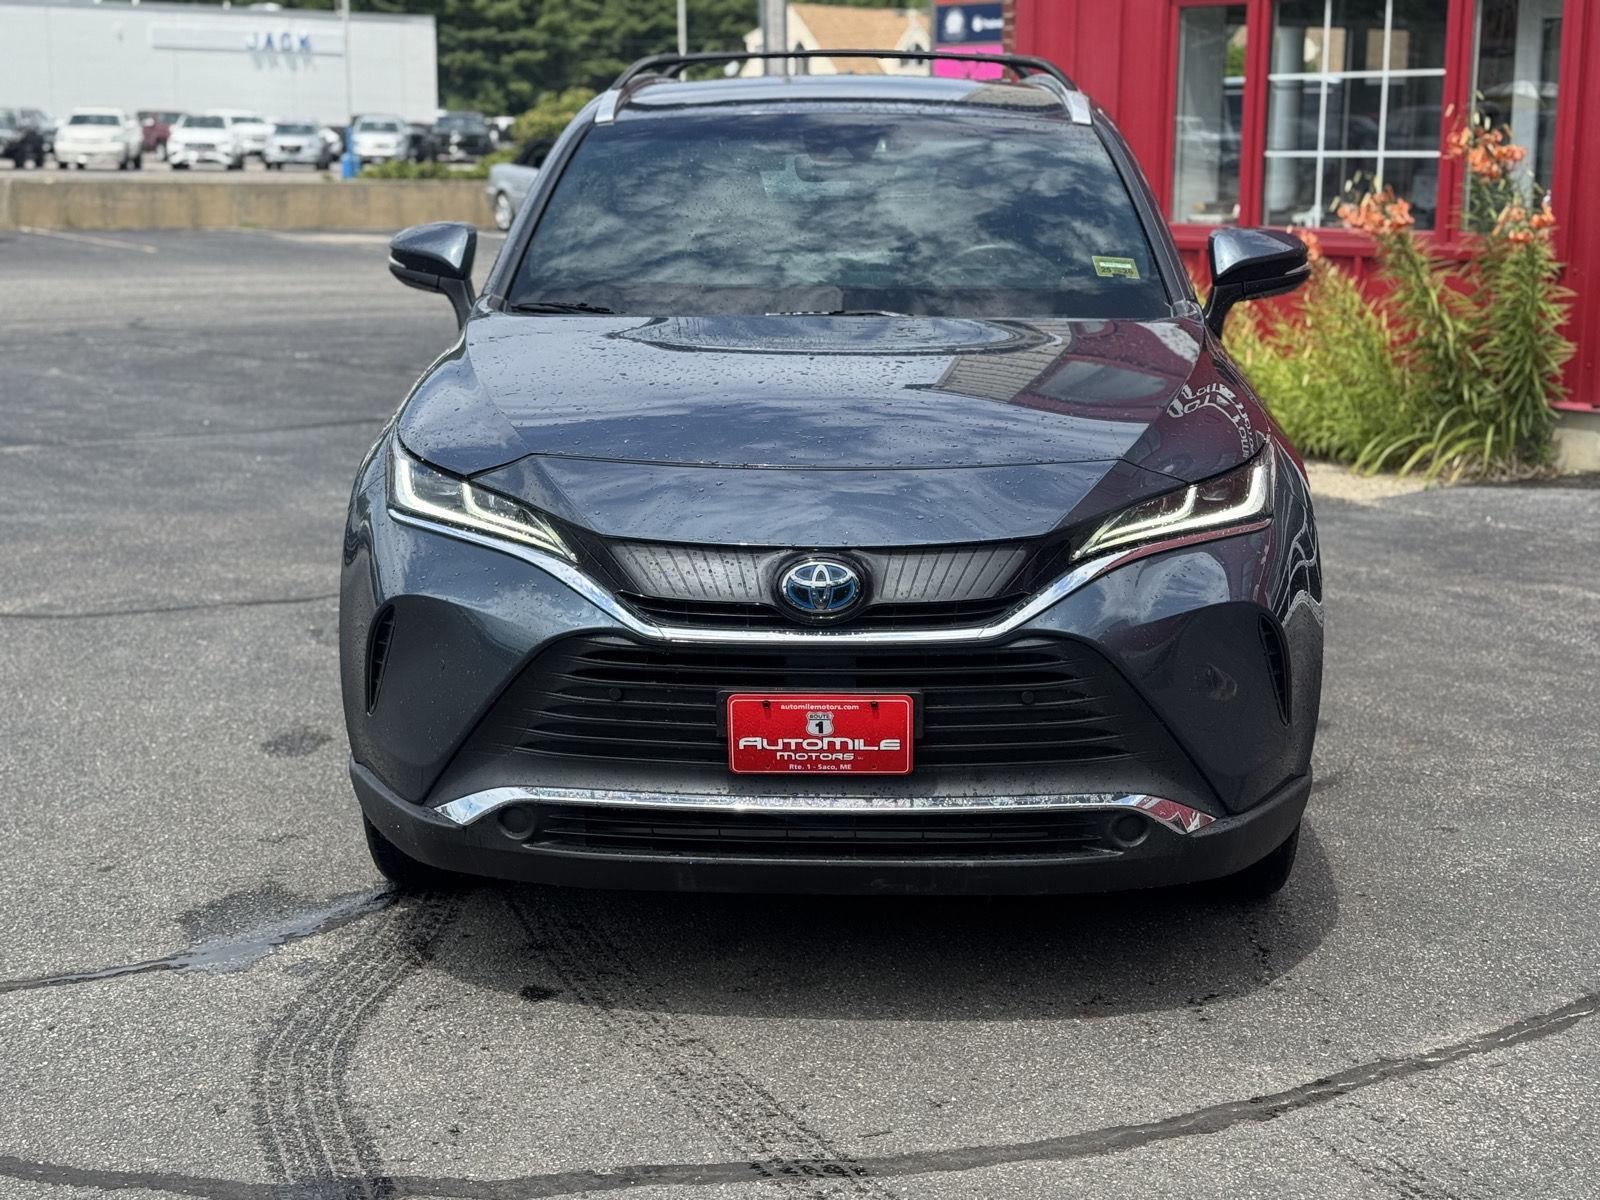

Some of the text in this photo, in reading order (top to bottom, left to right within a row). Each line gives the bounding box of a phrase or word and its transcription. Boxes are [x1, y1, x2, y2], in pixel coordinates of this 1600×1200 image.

[815, 721, 824, 734] 1
[738, 737, 901, 751] AUTOMILE
[776, 752, 854, 761] MOTORS
